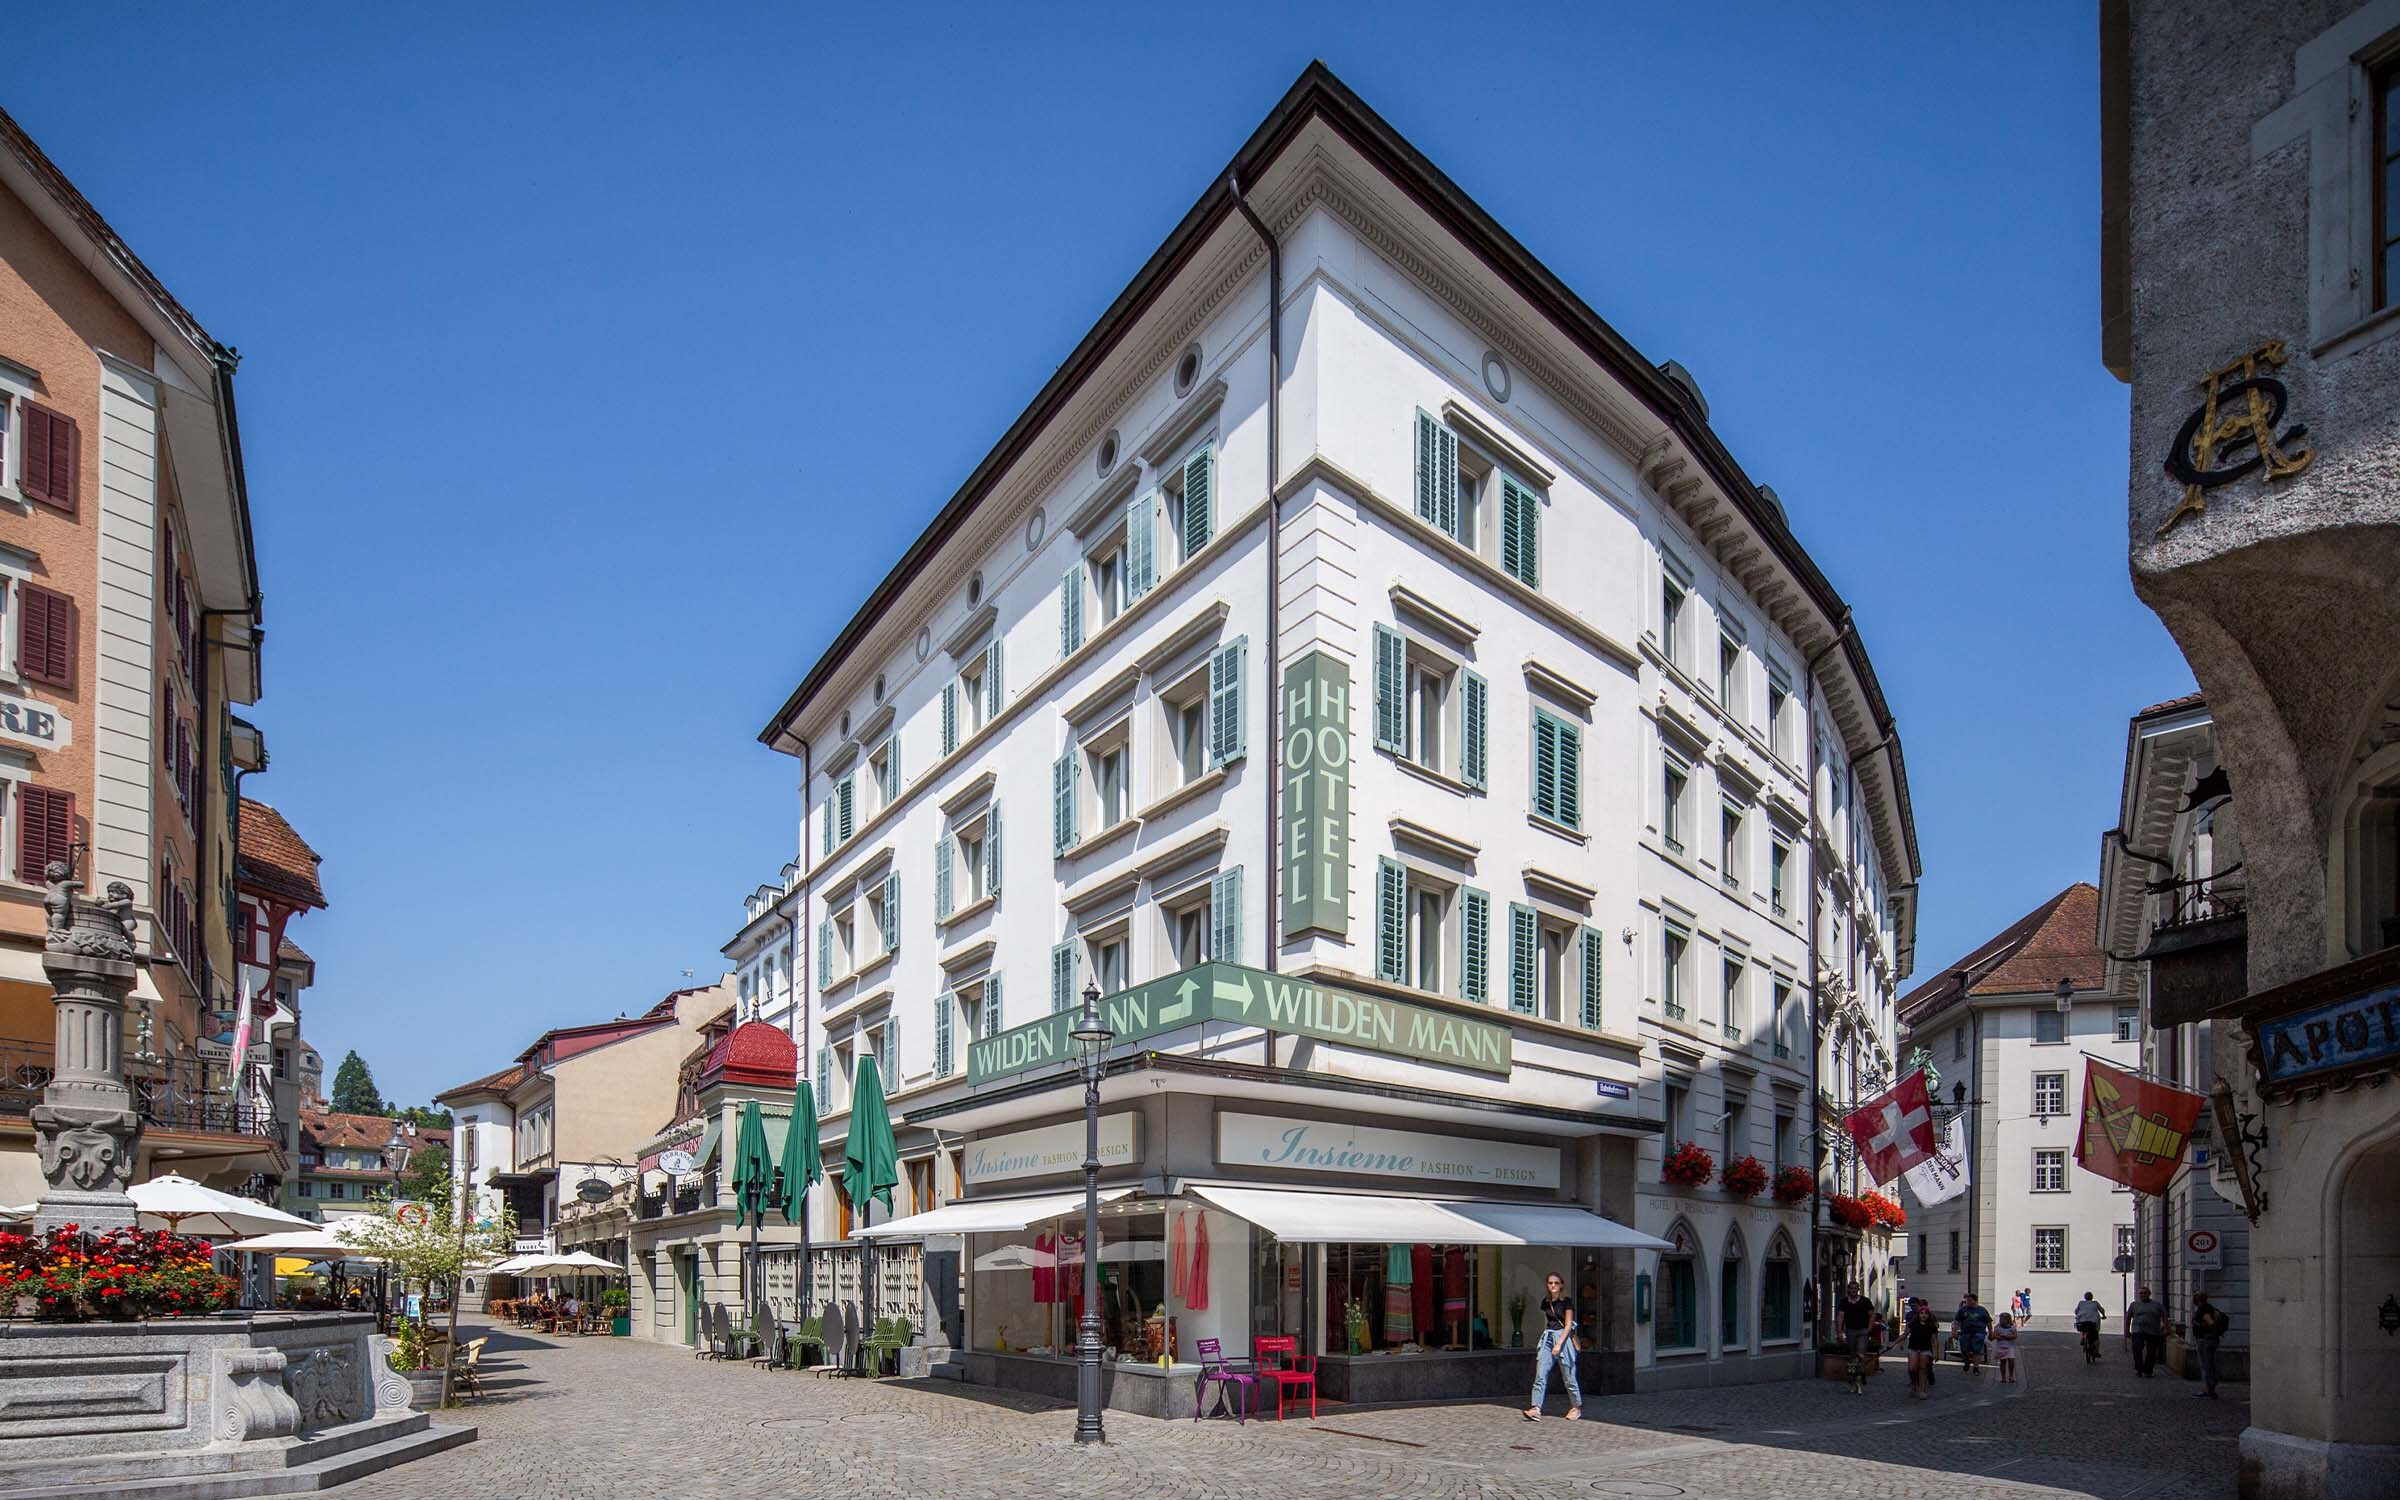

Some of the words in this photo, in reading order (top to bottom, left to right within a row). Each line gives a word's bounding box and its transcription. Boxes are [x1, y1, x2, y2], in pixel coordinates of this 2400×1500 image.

[1287, 678, 1313, 905] HOTEL
[1318, 677, 1347, 904] HOTEL
[976, 1021, 1054, 1077] WILDEN
[1064, 991, 1149, 1052] MNN
[1263, 980, 1396, 1044] WILDEN
[1408, 1013, 1501, 1064] MANN
[968, 1147, 1040, 1177] Insieme
[1041, 1151, 1079, 1166] FASHION
[1262, 1126, 1414, 1172] Insieme
[1421, 1161, 1473, 1177] FASHION
[1495, 1167, 1536, 1181] DESIGN
[1938, 1156, 1952, 1171] 500
